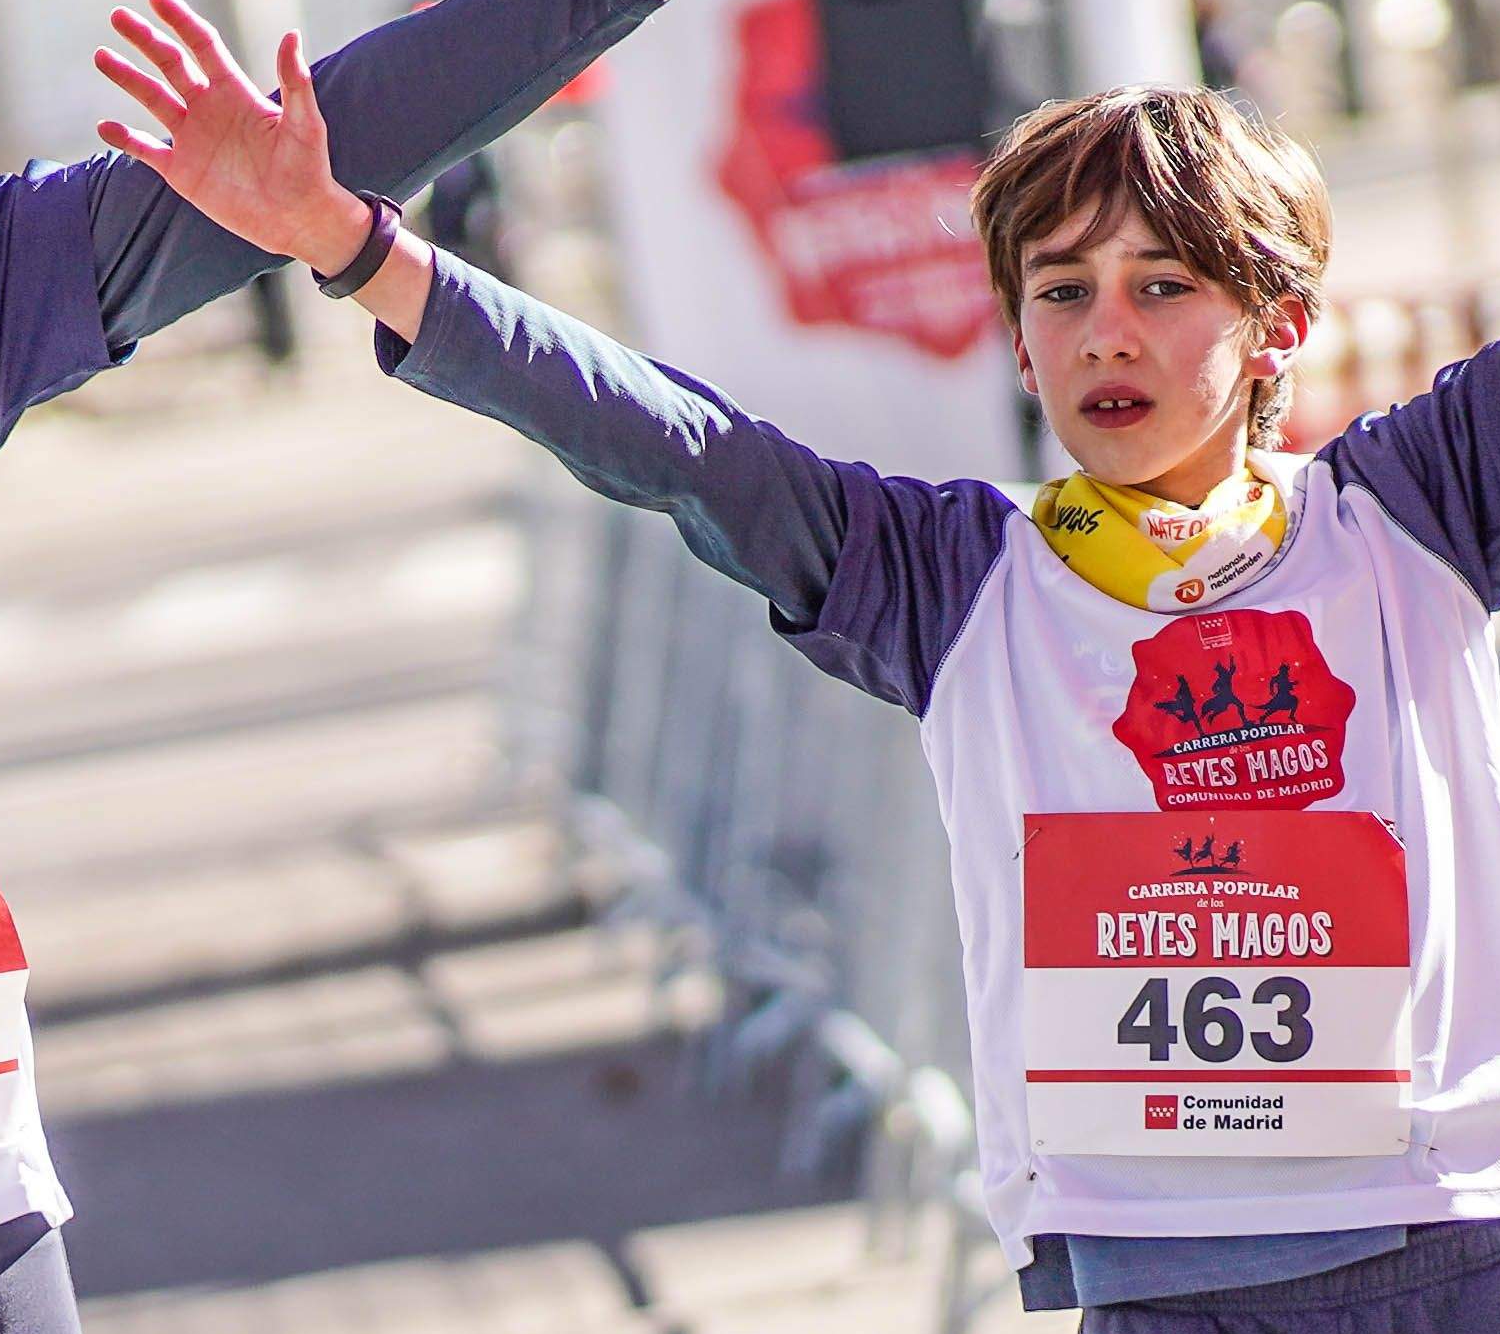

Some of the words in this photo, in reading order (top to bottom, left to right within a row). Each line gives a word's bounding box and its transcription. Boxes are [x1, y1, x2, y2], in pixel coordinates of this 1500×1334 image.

[1207, 551, 1246, 581] nationale
[1210, 551, 1263, 590] nederlanden
[1173, 733, 1237, 754] CARRERA
[1241, 723, 1304, 740] POPULAR
[1163, 756, 1237, 787] REYES
[1245, 739, 1329, 783] MAGOS
[1168, 791, 1251, 805] COMUNIDAD
[1257, 789, 1275, 799] DE
[1279, 778, 1333, 796] MADRID
[1128, 881, 1208, 900] CARRERA
[1212, 881, 1299, 900] POPULAR
[1197, 898, 1210, 908] de
[1211, 898, 1224, 908] los
[1096, 910, 1198, 959] REYES
[1212, 910, 1333, 959] MAGOS
[1116, 975, 1314, 1064] 463
[1183, 1095, 1284, 1110] Comunidad
[1183, 1113, 1207, 1130] de
[1213, 1113, 1284, 1130] Madrid
